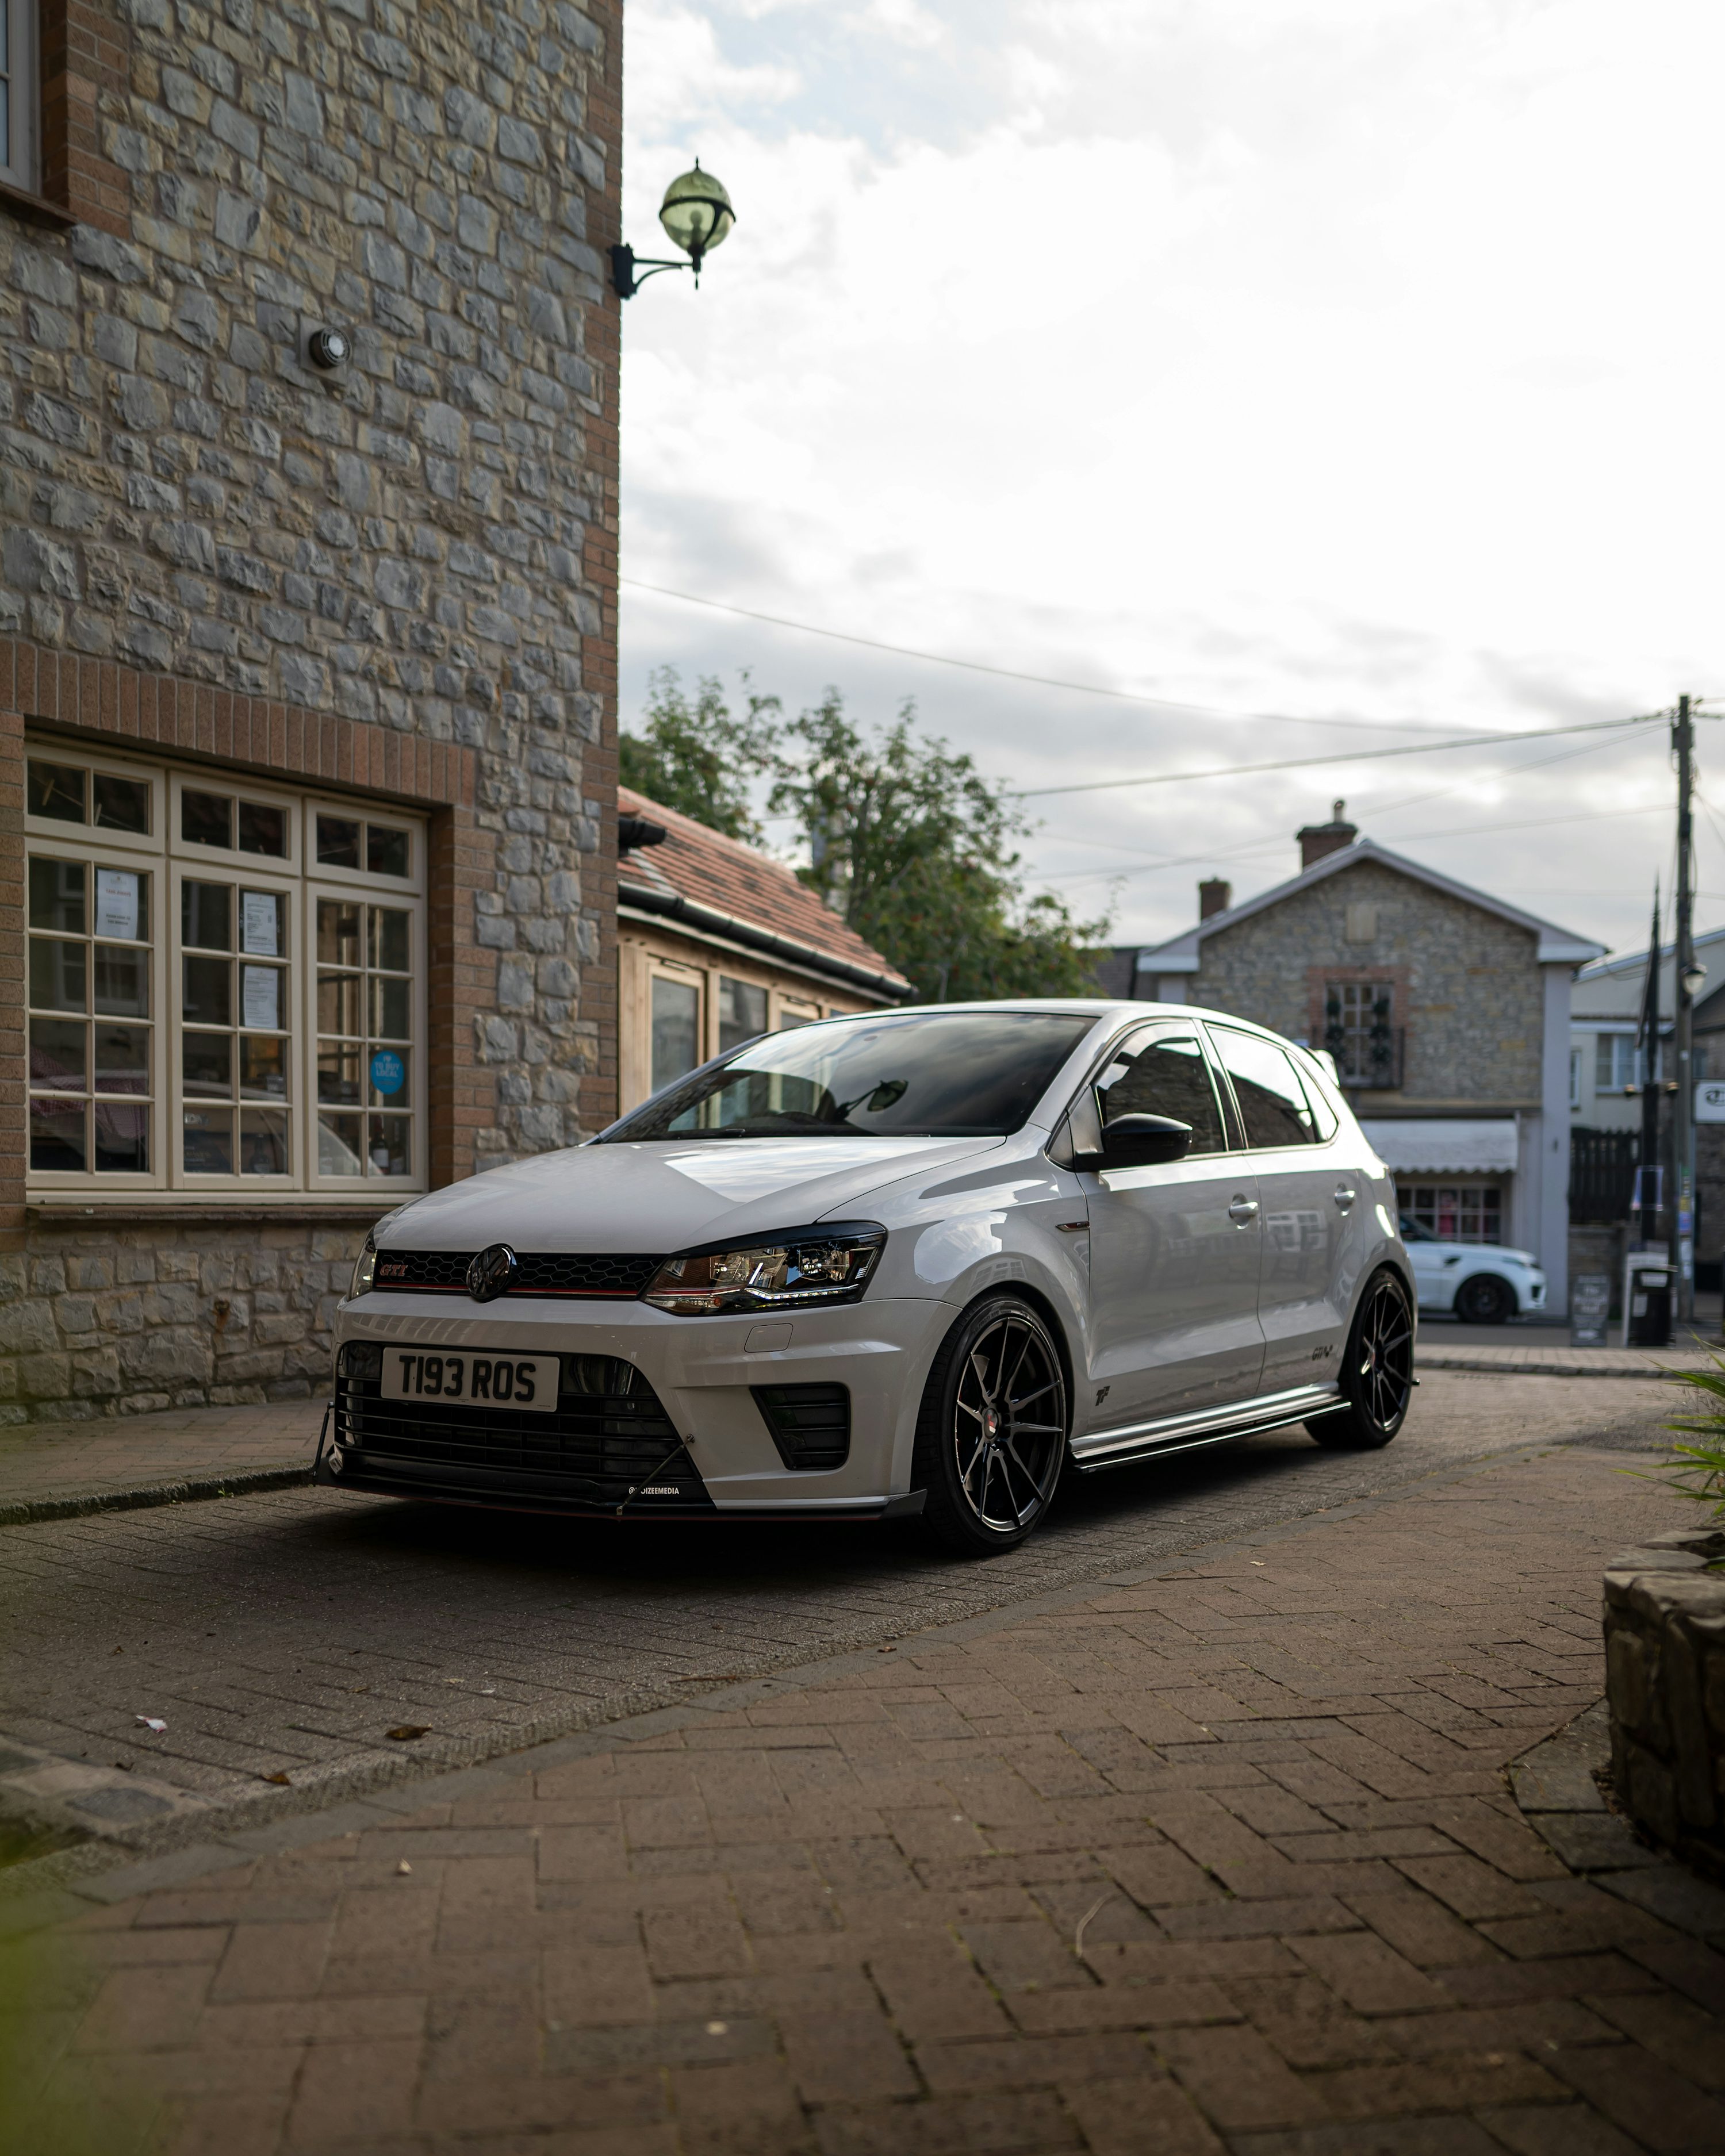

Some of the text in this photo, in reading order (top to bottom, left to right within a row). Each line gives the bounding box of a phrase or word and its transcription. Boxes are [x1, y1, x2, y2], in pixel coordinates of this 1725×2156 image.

[375, 1061, 400, 1071] TO BUY
[376, 1069, 398, 1077] LOCAL
[379, 1264, 408, 1276] GTI
[399, 1355, 536, 1402] T193 ROS
[628, 1487, 680, 1495] @OIZEEMEDIA
